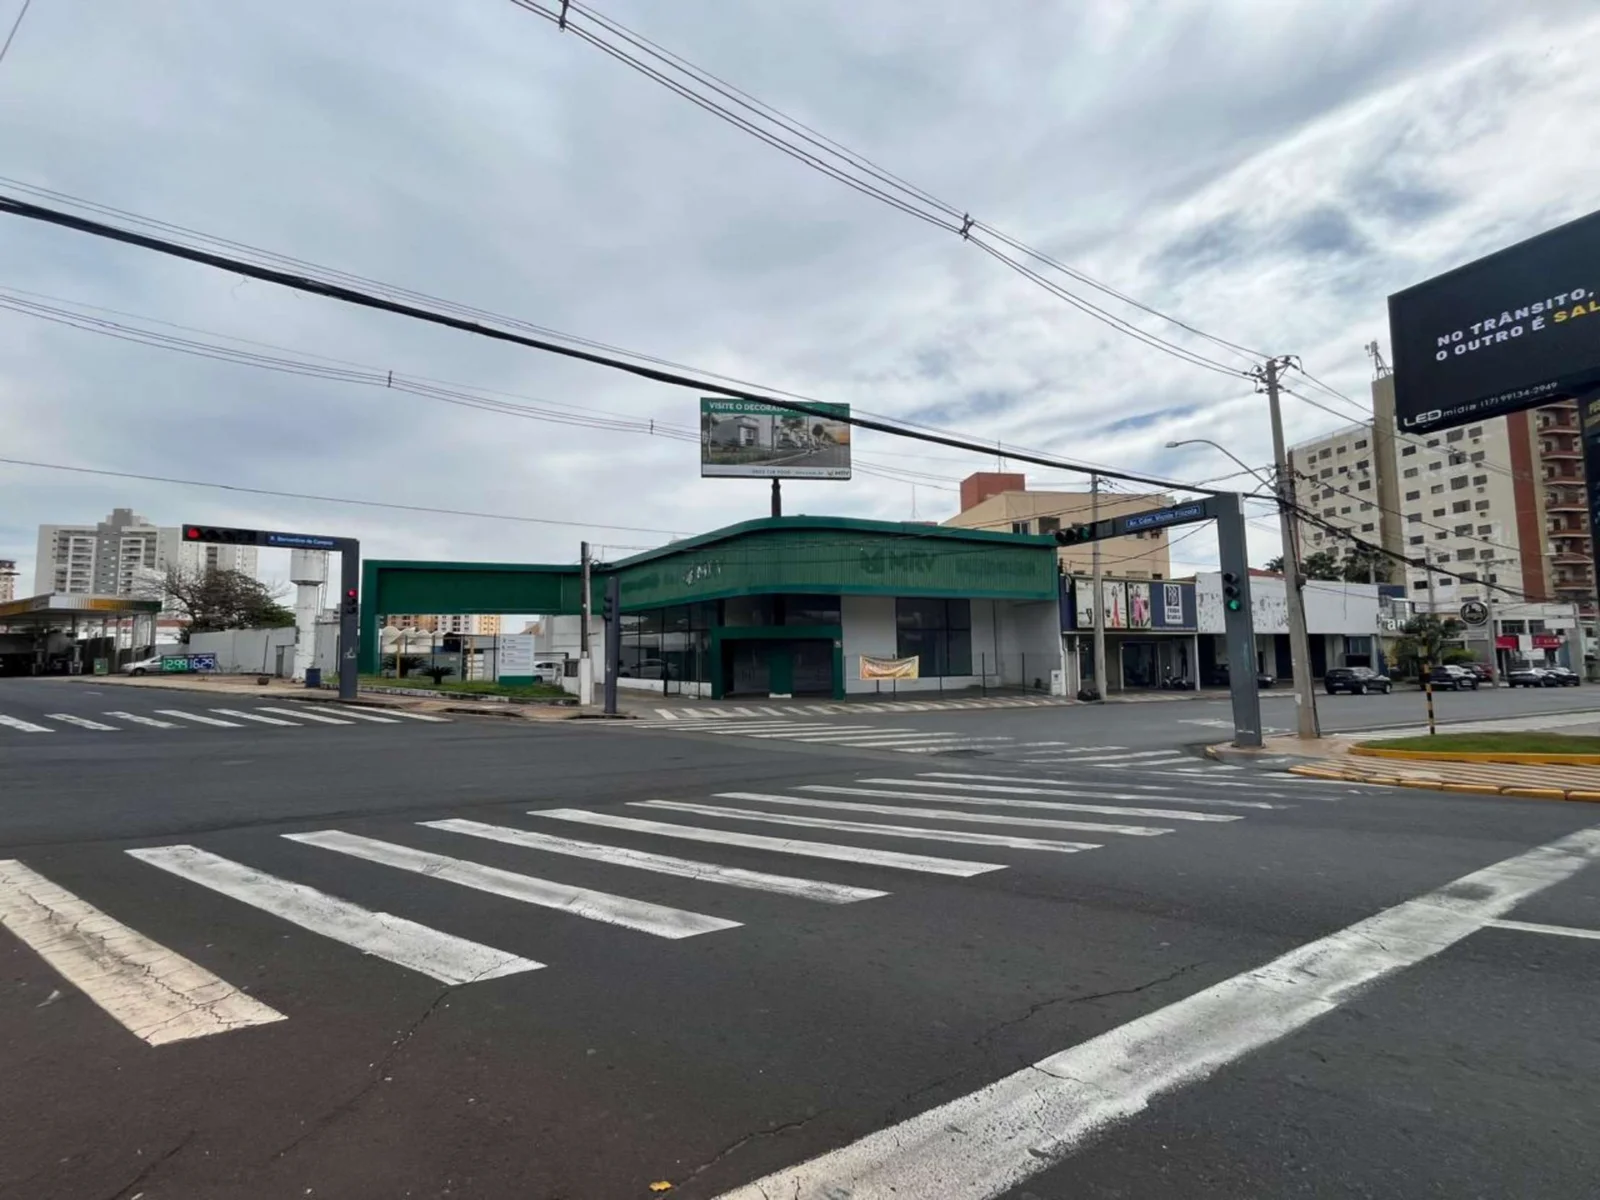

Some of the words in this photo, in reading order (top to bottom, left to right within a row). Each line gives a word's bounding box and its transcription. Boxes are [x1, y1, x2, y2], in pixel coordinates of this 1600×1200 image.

[1436, 350, 1448, 361] O
[1454, 326, 1523, 355] OUTRO
[1532, 316, 1546, 331] É
[1437, 331, 1464, 347] NO
[709, 402, 734, 410] VISITE
